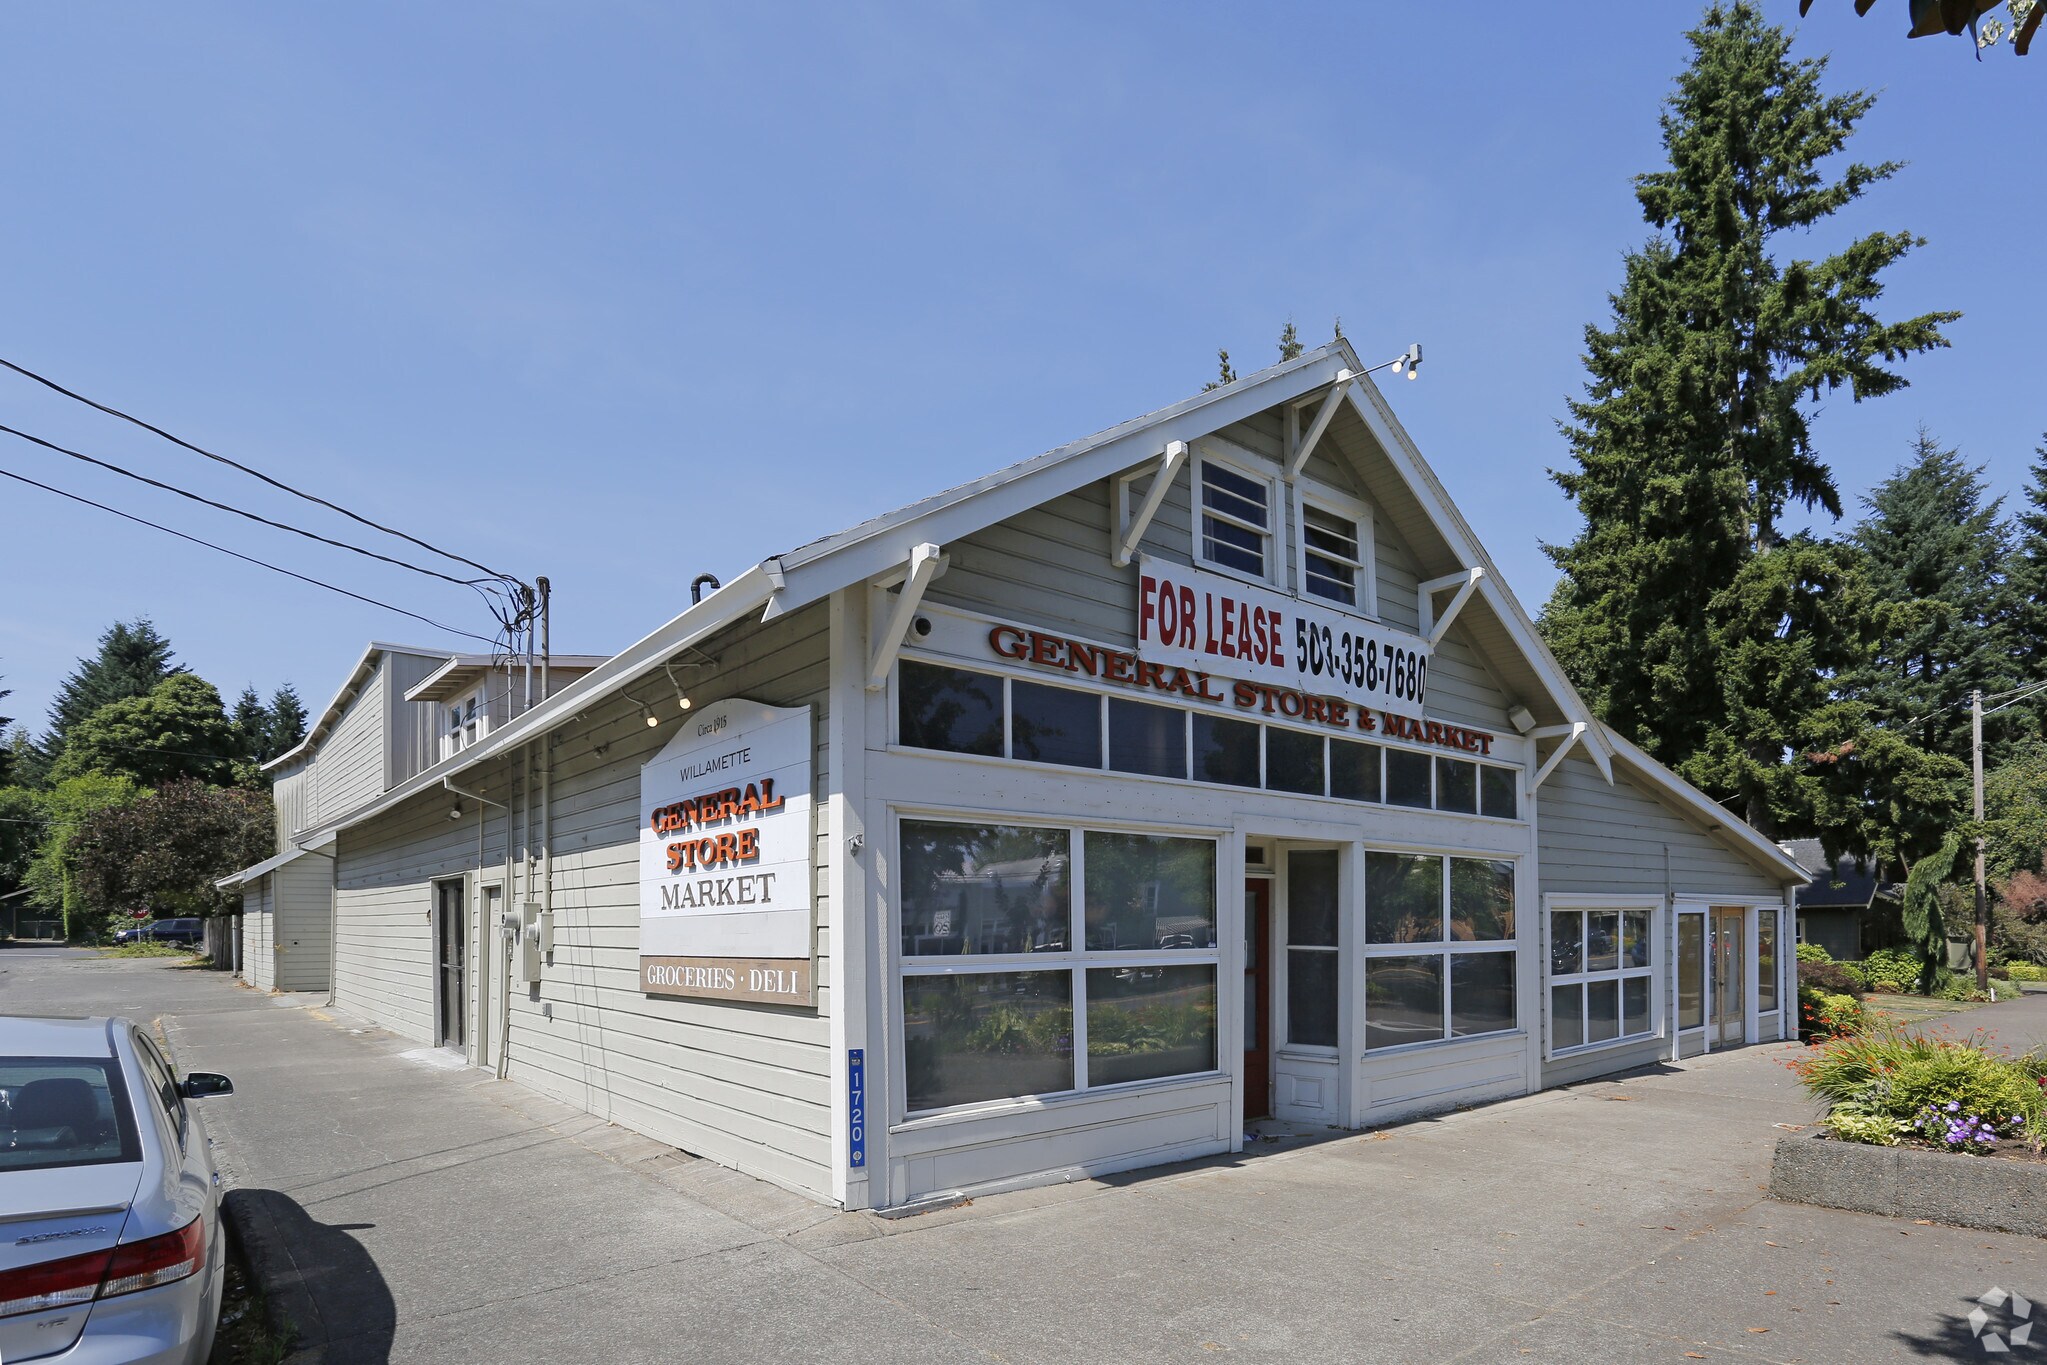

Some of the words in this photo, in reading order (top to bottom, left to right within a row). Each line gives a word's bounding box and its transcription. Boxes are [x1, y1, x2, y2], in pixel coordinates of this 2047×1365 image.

[1139, 575, 1196, 650] FOR
[1205, 592, 1285, 668] LEASE
[1296, 617, 1426, 705] 503-358-7680
[989, 626, 1224, 702] GENERAL
[1234, 680, 1350, 727] STORE
[1358, 708, 1376, 731] &
[1381, 713, 1494, 755] MARKET
[697, 724, 713, 737] Circa
[680, 747, 751, 782] WILLAMETTE
[650, 778, 784, 834] GENERAL
[666, 828, 758, 870] STORE
[661, 873, 776, 911] MARKET
[647, 965, 735, 990] GROCERIES
[750, 969, 798, 993] DELI
[852, 1072, 862, 1142] 1720
